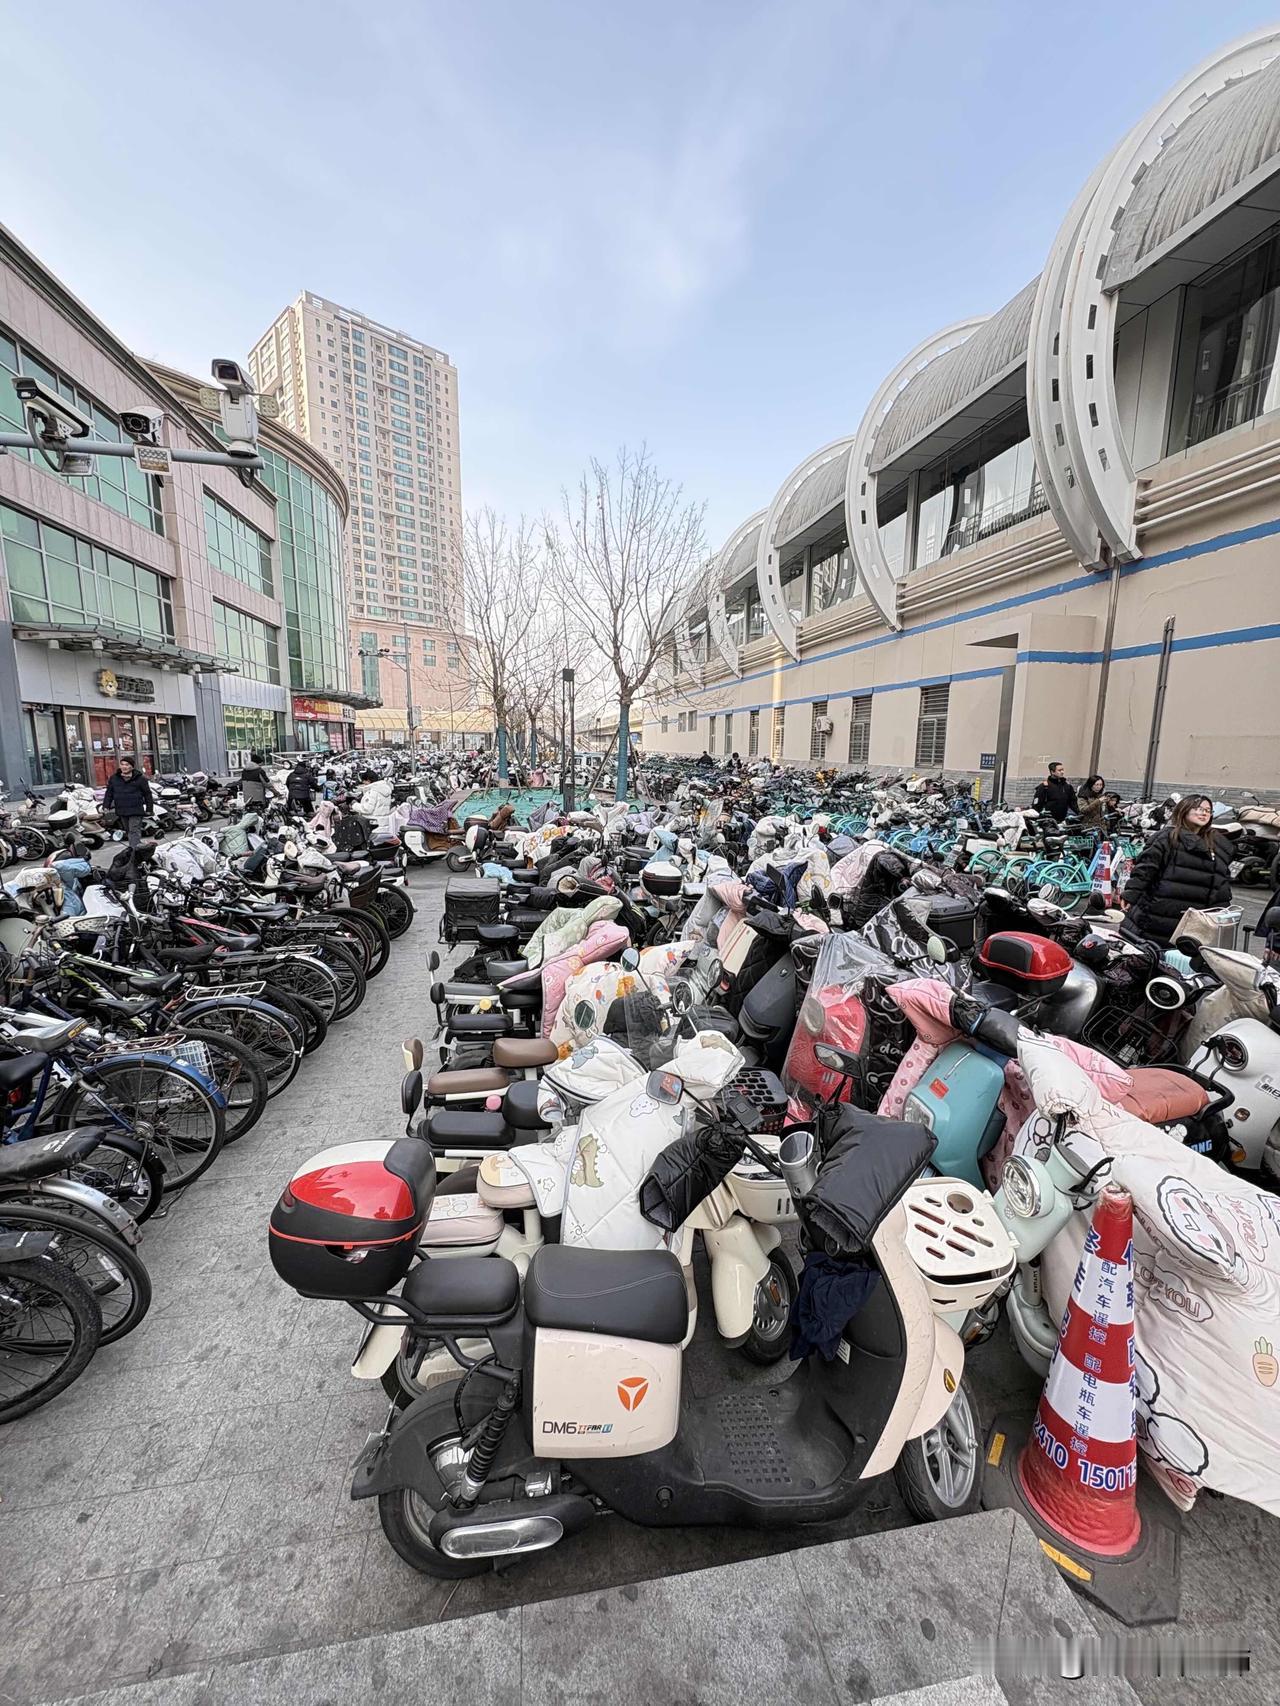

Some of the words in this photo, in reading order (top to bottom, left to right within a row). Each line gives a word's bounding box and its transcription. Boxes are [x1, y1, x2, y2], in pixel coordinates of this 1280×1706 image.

[1188, 1139, 1213, 1153] ONG
[1089, 1260, 1118, 1345] 配汽车遥控
[543, 1421, 577, 1434] DM6
[1070, 1353, 1102, 1457] 配电瓶车遥控
